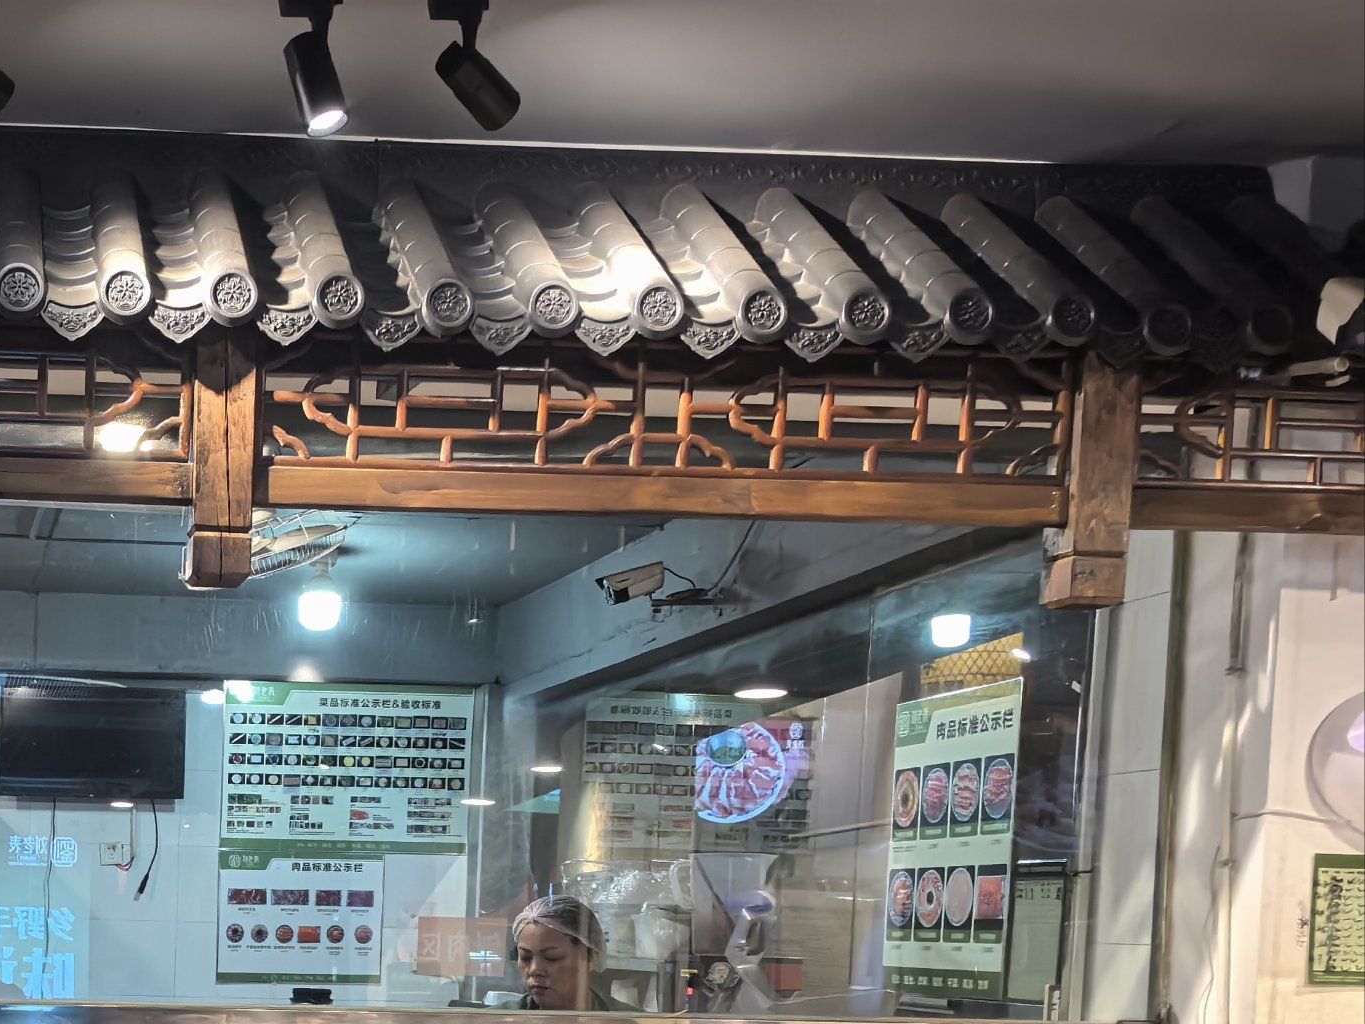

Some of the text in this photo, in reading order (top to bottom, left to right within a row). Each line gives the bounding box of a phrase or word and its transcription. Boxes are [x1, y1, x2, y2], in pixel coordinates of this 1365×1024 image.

[937, 708, 1013, 740] 肉品标准公示栏
[292, 862, 362, 872] 肉品标准公示栏
